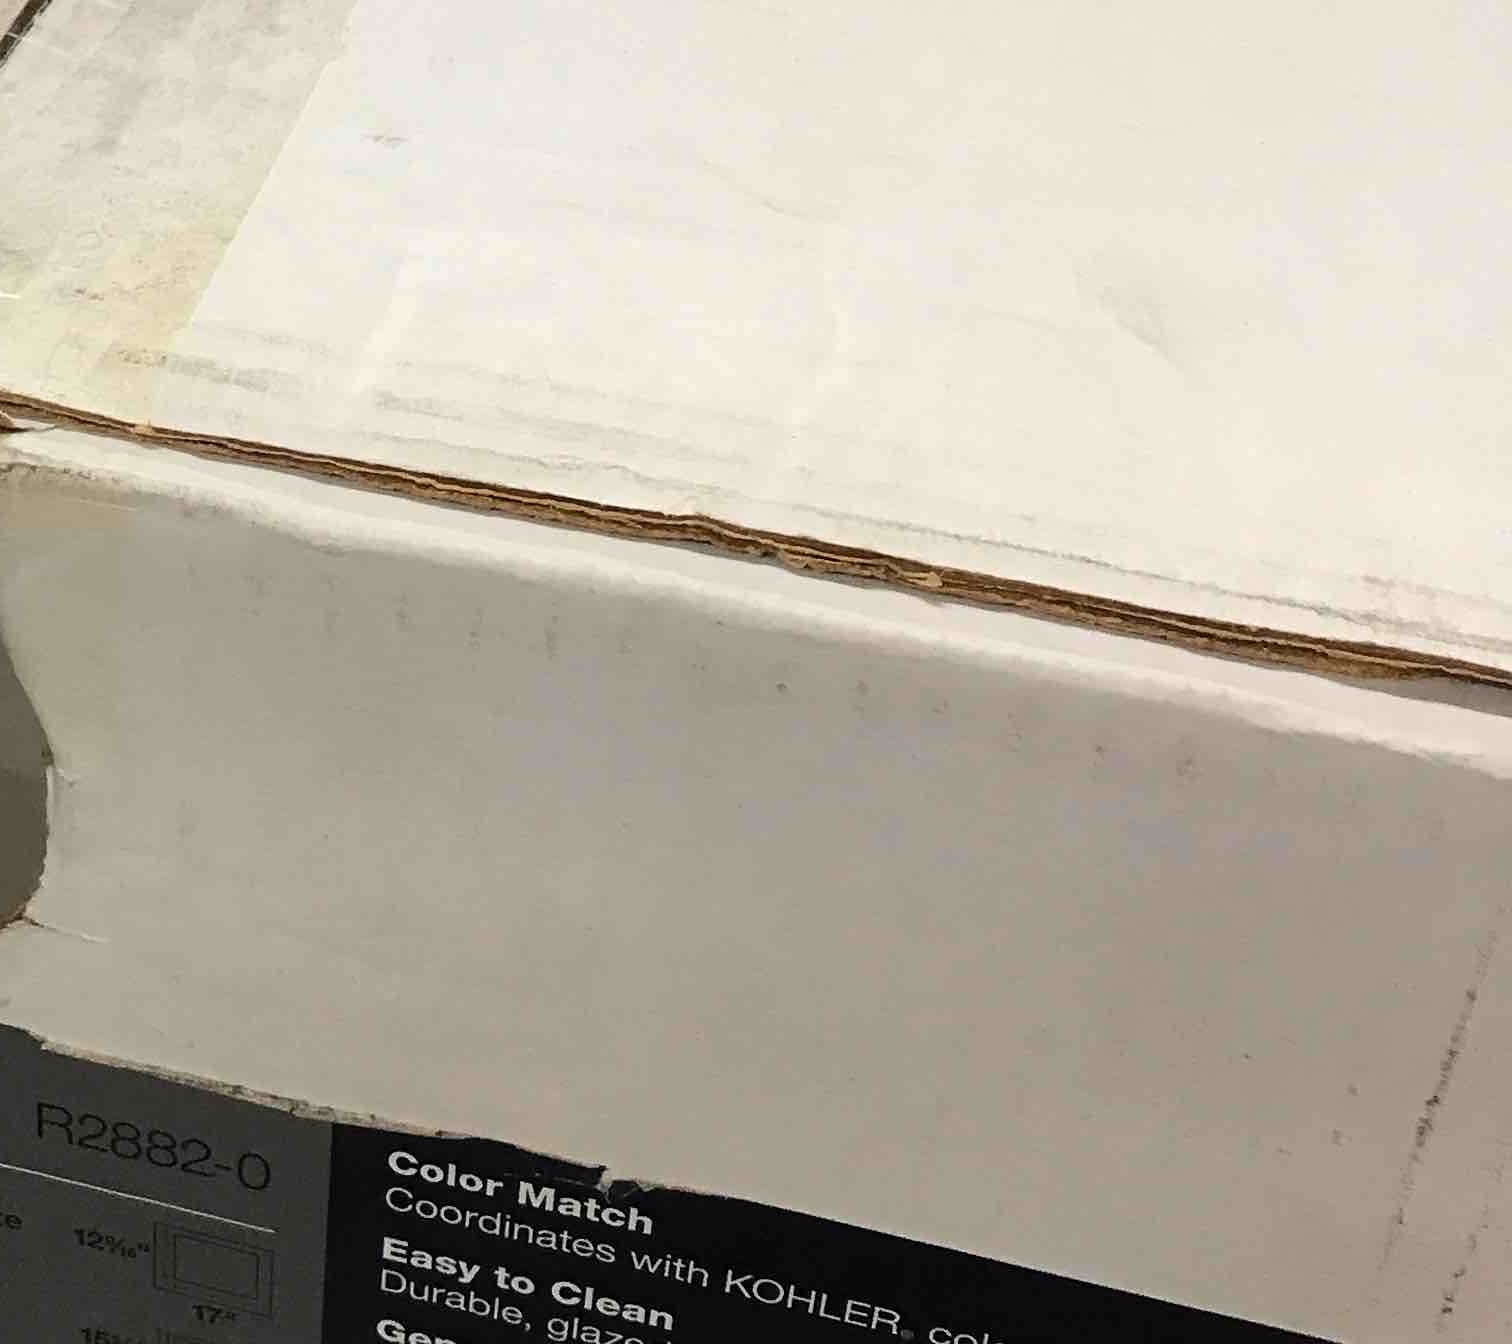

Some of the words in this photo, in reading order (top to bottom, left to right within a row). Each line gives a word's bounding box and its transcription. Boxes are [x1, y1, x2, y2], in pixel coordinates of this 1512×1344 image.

[37, 1101, 271, 1191] R2882-0
[385, 1187, 616, 1264] Coordinates
[631, 1251, 709, 1288] with
[387, 1151, 504, 1196] Color
[517, 1180, 653, 1235] Match
[380, 1269, 533, 1332] Durable,
[381, 1236, 480, 1284] Easy
[494, 1266, 535, 1295] to
[551, 1281, 674, 1331] Clean
